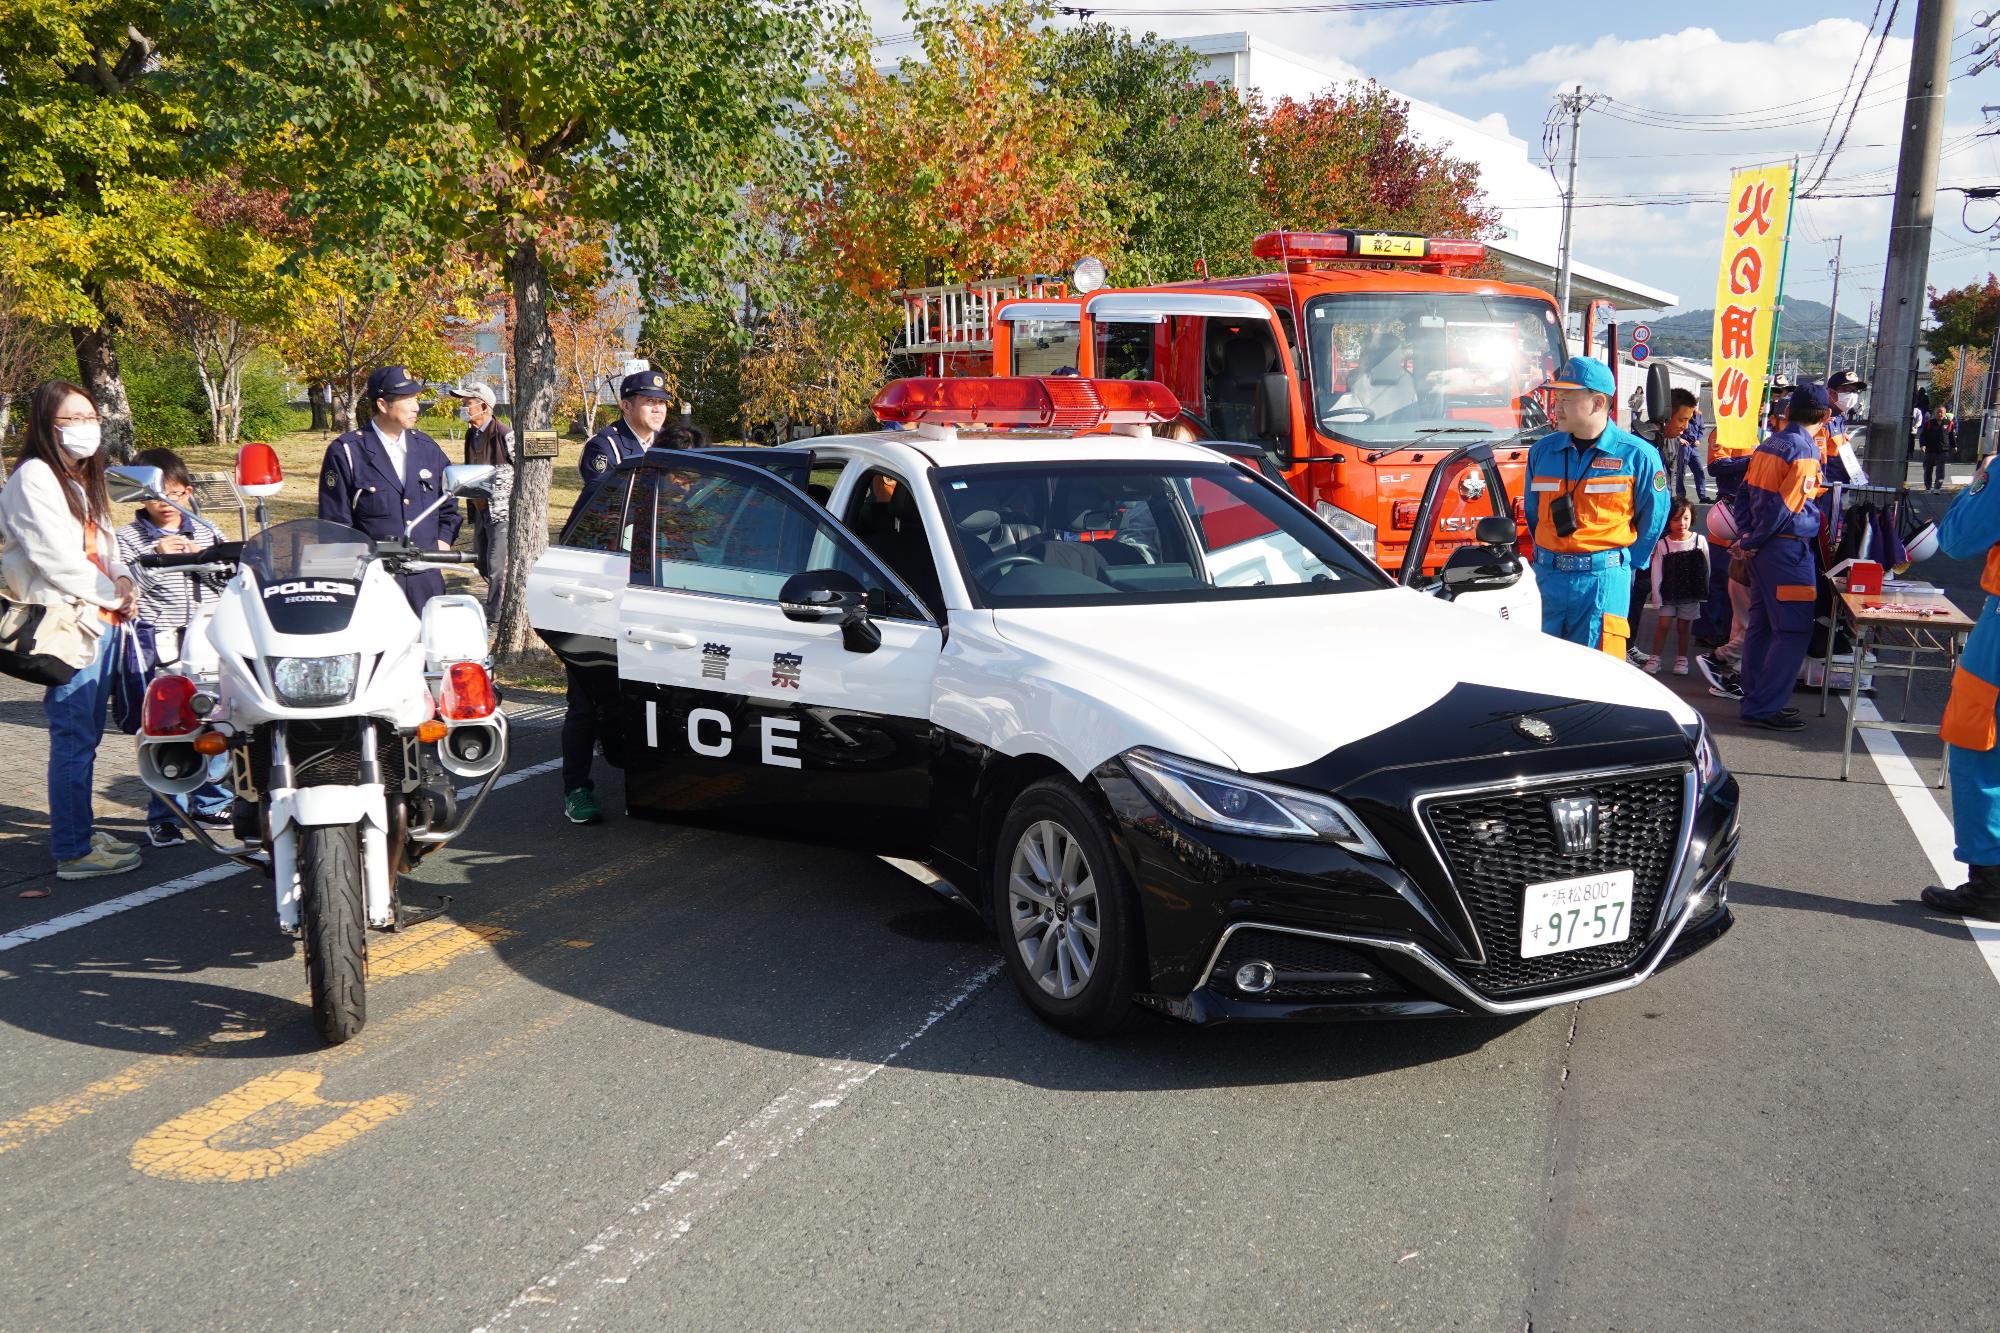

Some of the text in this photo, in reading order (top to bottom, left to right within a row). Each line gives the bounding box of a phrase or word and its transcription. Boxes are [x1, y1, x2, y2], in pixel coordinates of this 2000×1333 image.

[1717, 180, 1774, 418] 火の用心
[1636, 330, 1647, 339] 40
[1379, 474, 1411, 483] ELF
[263, 580, 357, 599] POLICE
[284, 595, 338, 603] HONDA
[701, 642, 803, 690] 警察
[1530, 901, 1625, 947] す 97-57
